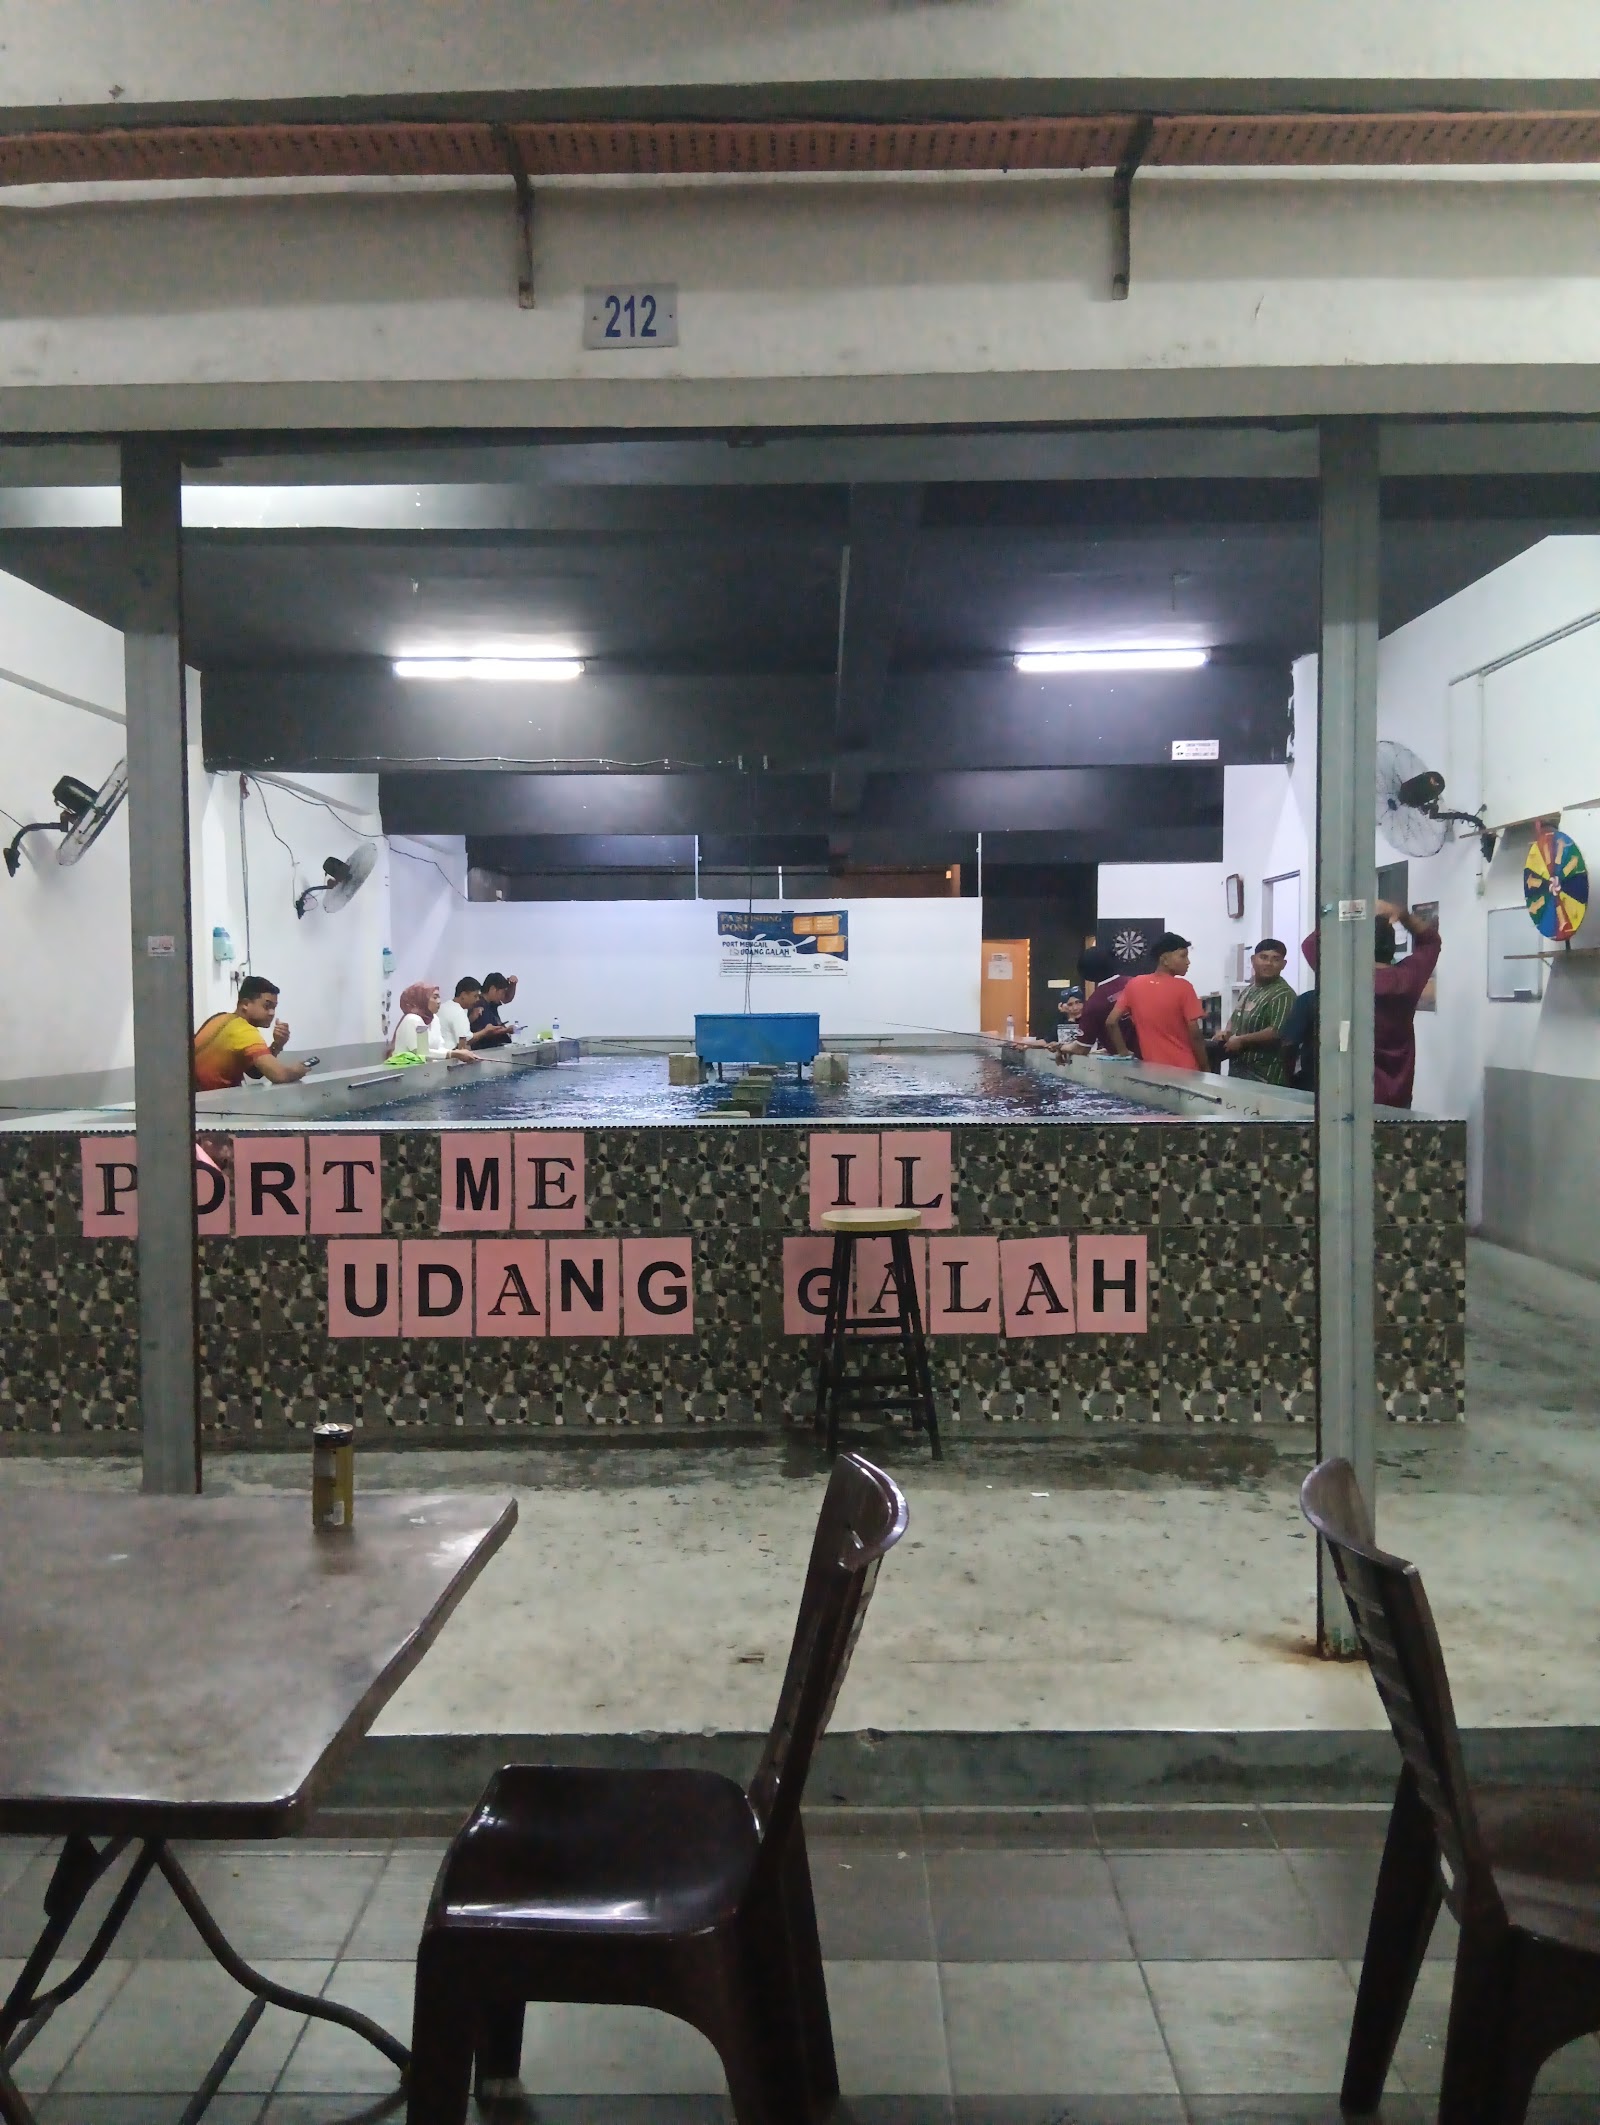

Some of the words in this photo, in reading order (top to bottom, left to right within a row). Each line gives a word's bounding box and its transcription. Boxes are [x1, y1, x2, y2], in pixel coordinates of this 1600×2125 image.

[604, 294, 657, 338] 212
[740, 948, 764, 956] UDANG
[765, 948, 790, 956] GALAH
[456, 1156, 578, 1212] ME
[830, 1153, 944, 1208] IL
[344, 1258, 688, 1317] UDANG
[798, 1258, 1137, 1316] GALAH
